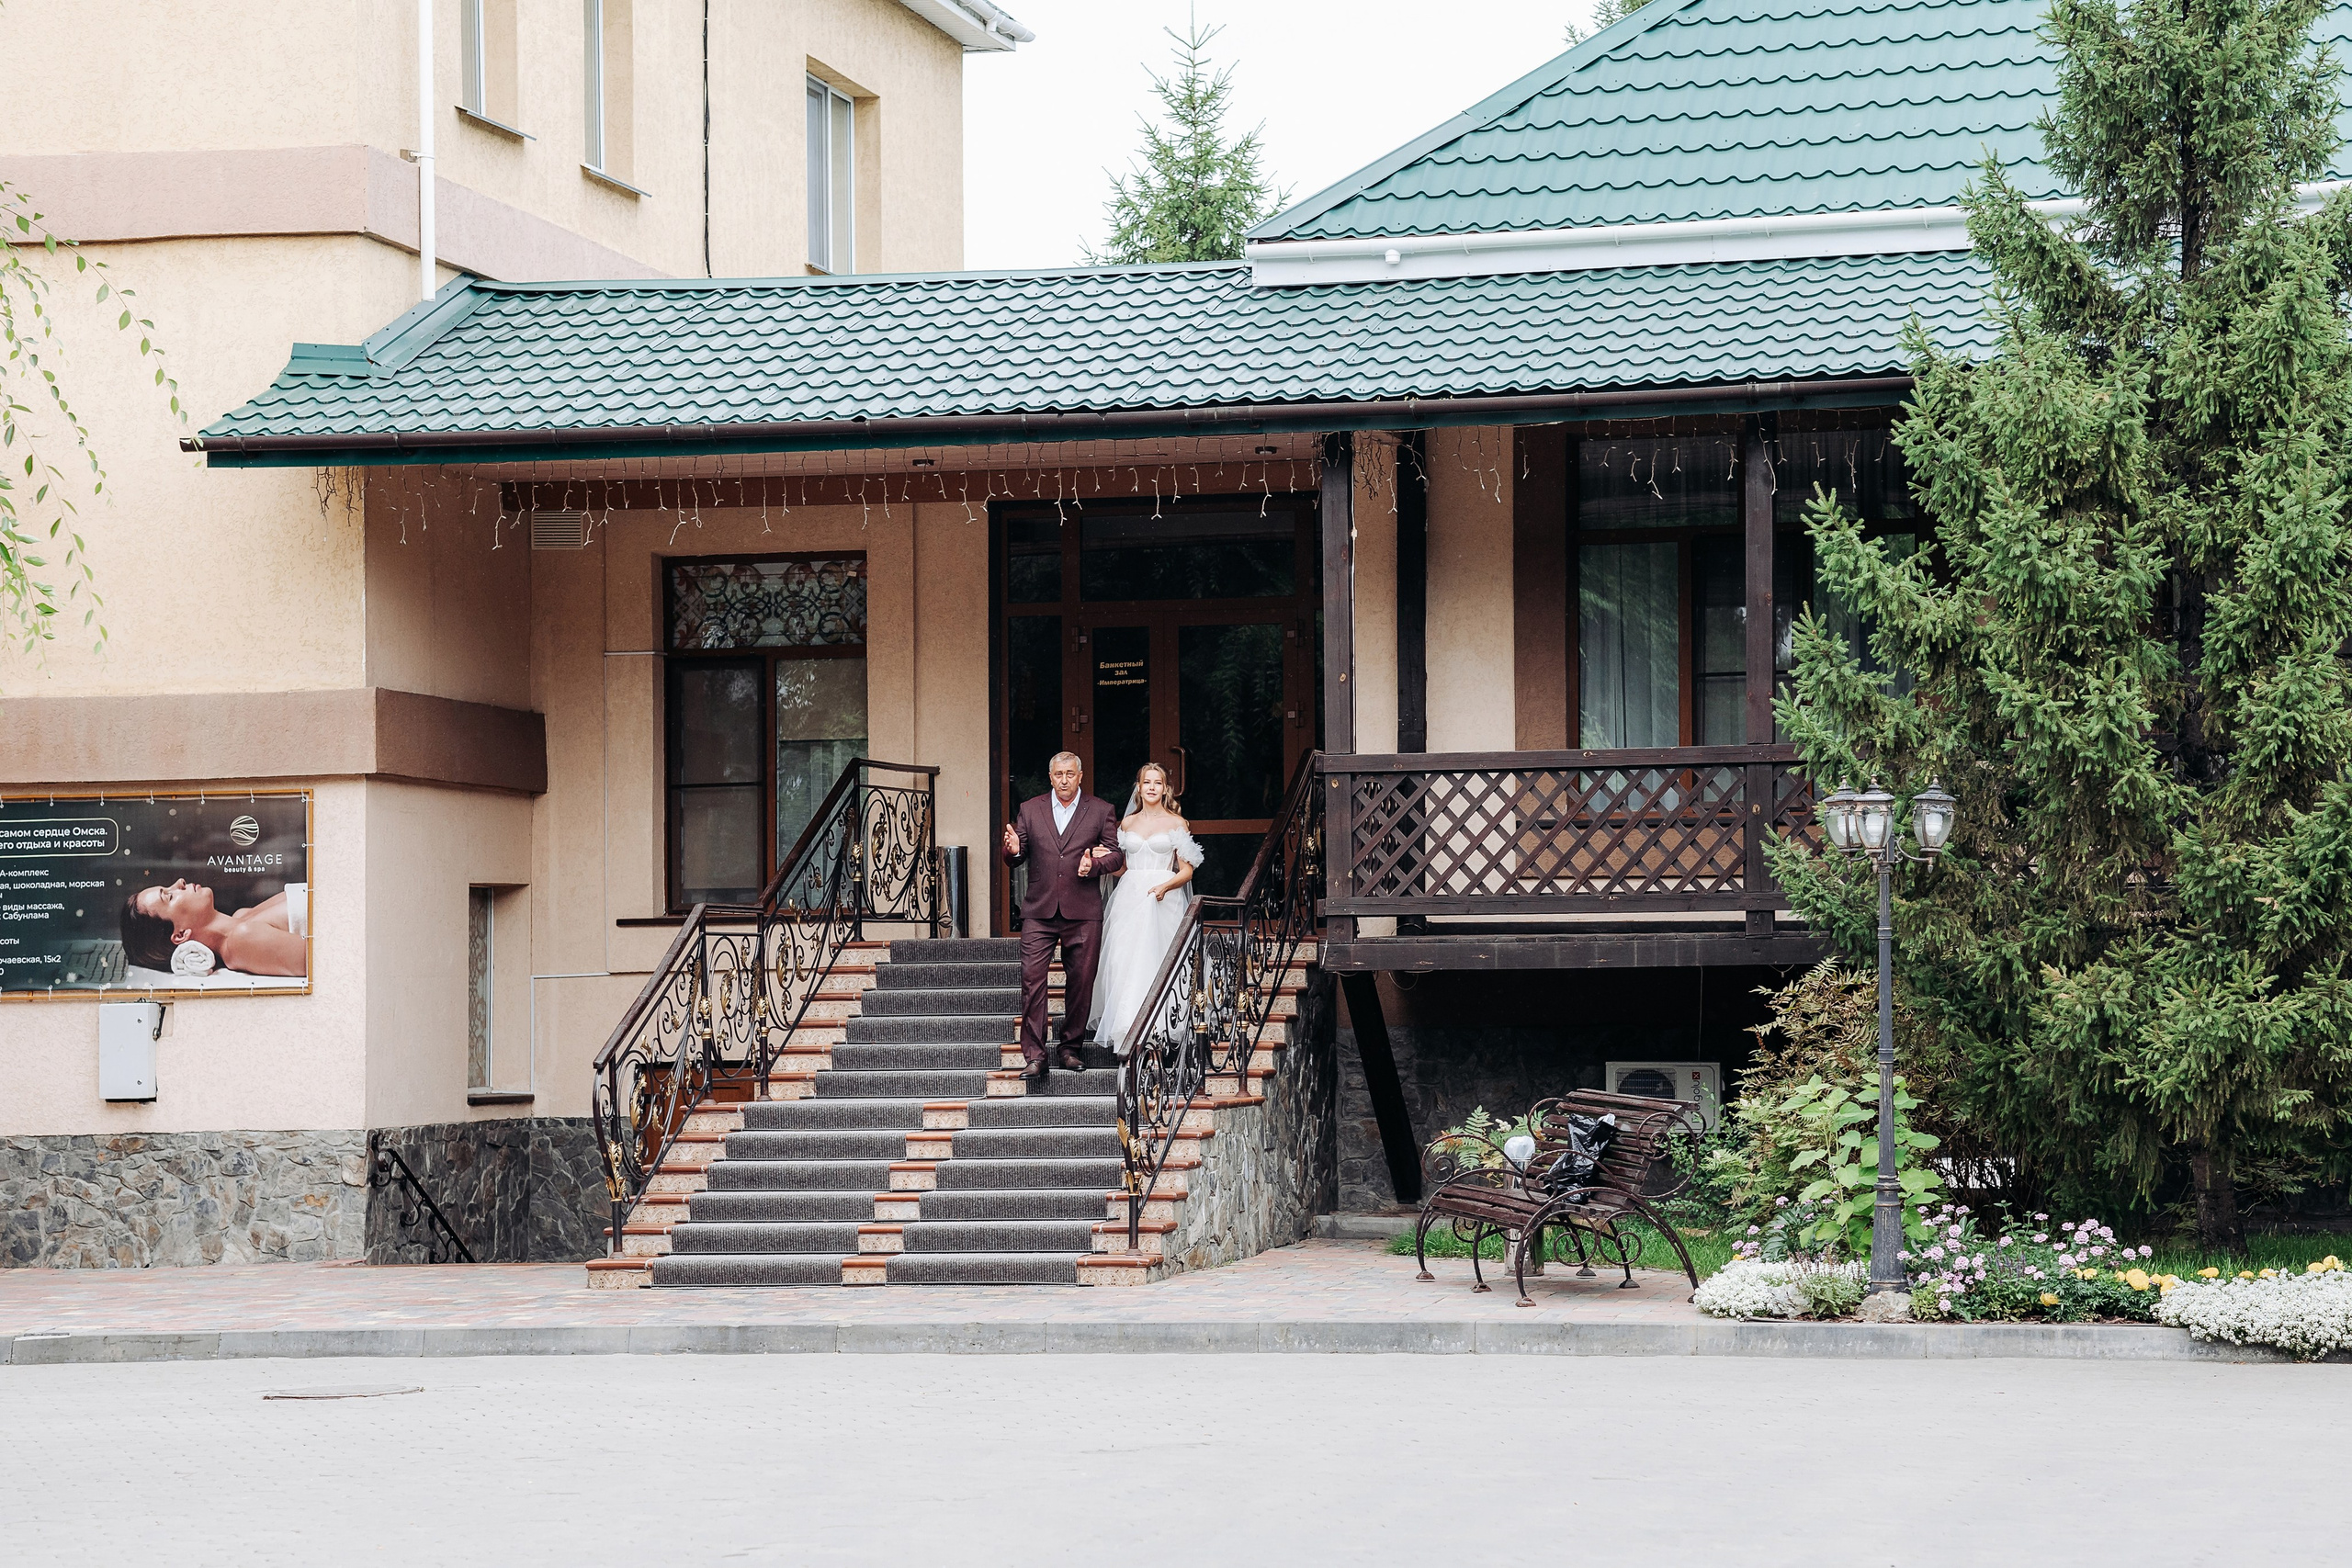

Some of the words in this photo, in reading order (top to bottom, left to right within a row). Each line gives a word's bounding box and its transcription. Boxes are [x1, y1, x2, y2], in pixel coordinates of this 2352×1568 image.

[1099, 660, 1144, 669] Банкетный
[0, 829, 31, 838] самом
[33, 829, 71, 838] сердце
[73, 827, 107, 836] Омска.
[16, 840, 51, 850] отдыха
[62, 840, 105, 850] красоты
[207, 853, 283, 866] AVANTAGE
[13, 881, 67, 890] шоколадная,
[69, 880, 105, 889] морская
[2, 912, 50, 921] Сабунлама
[43, 954, 62, 964] 15к2
